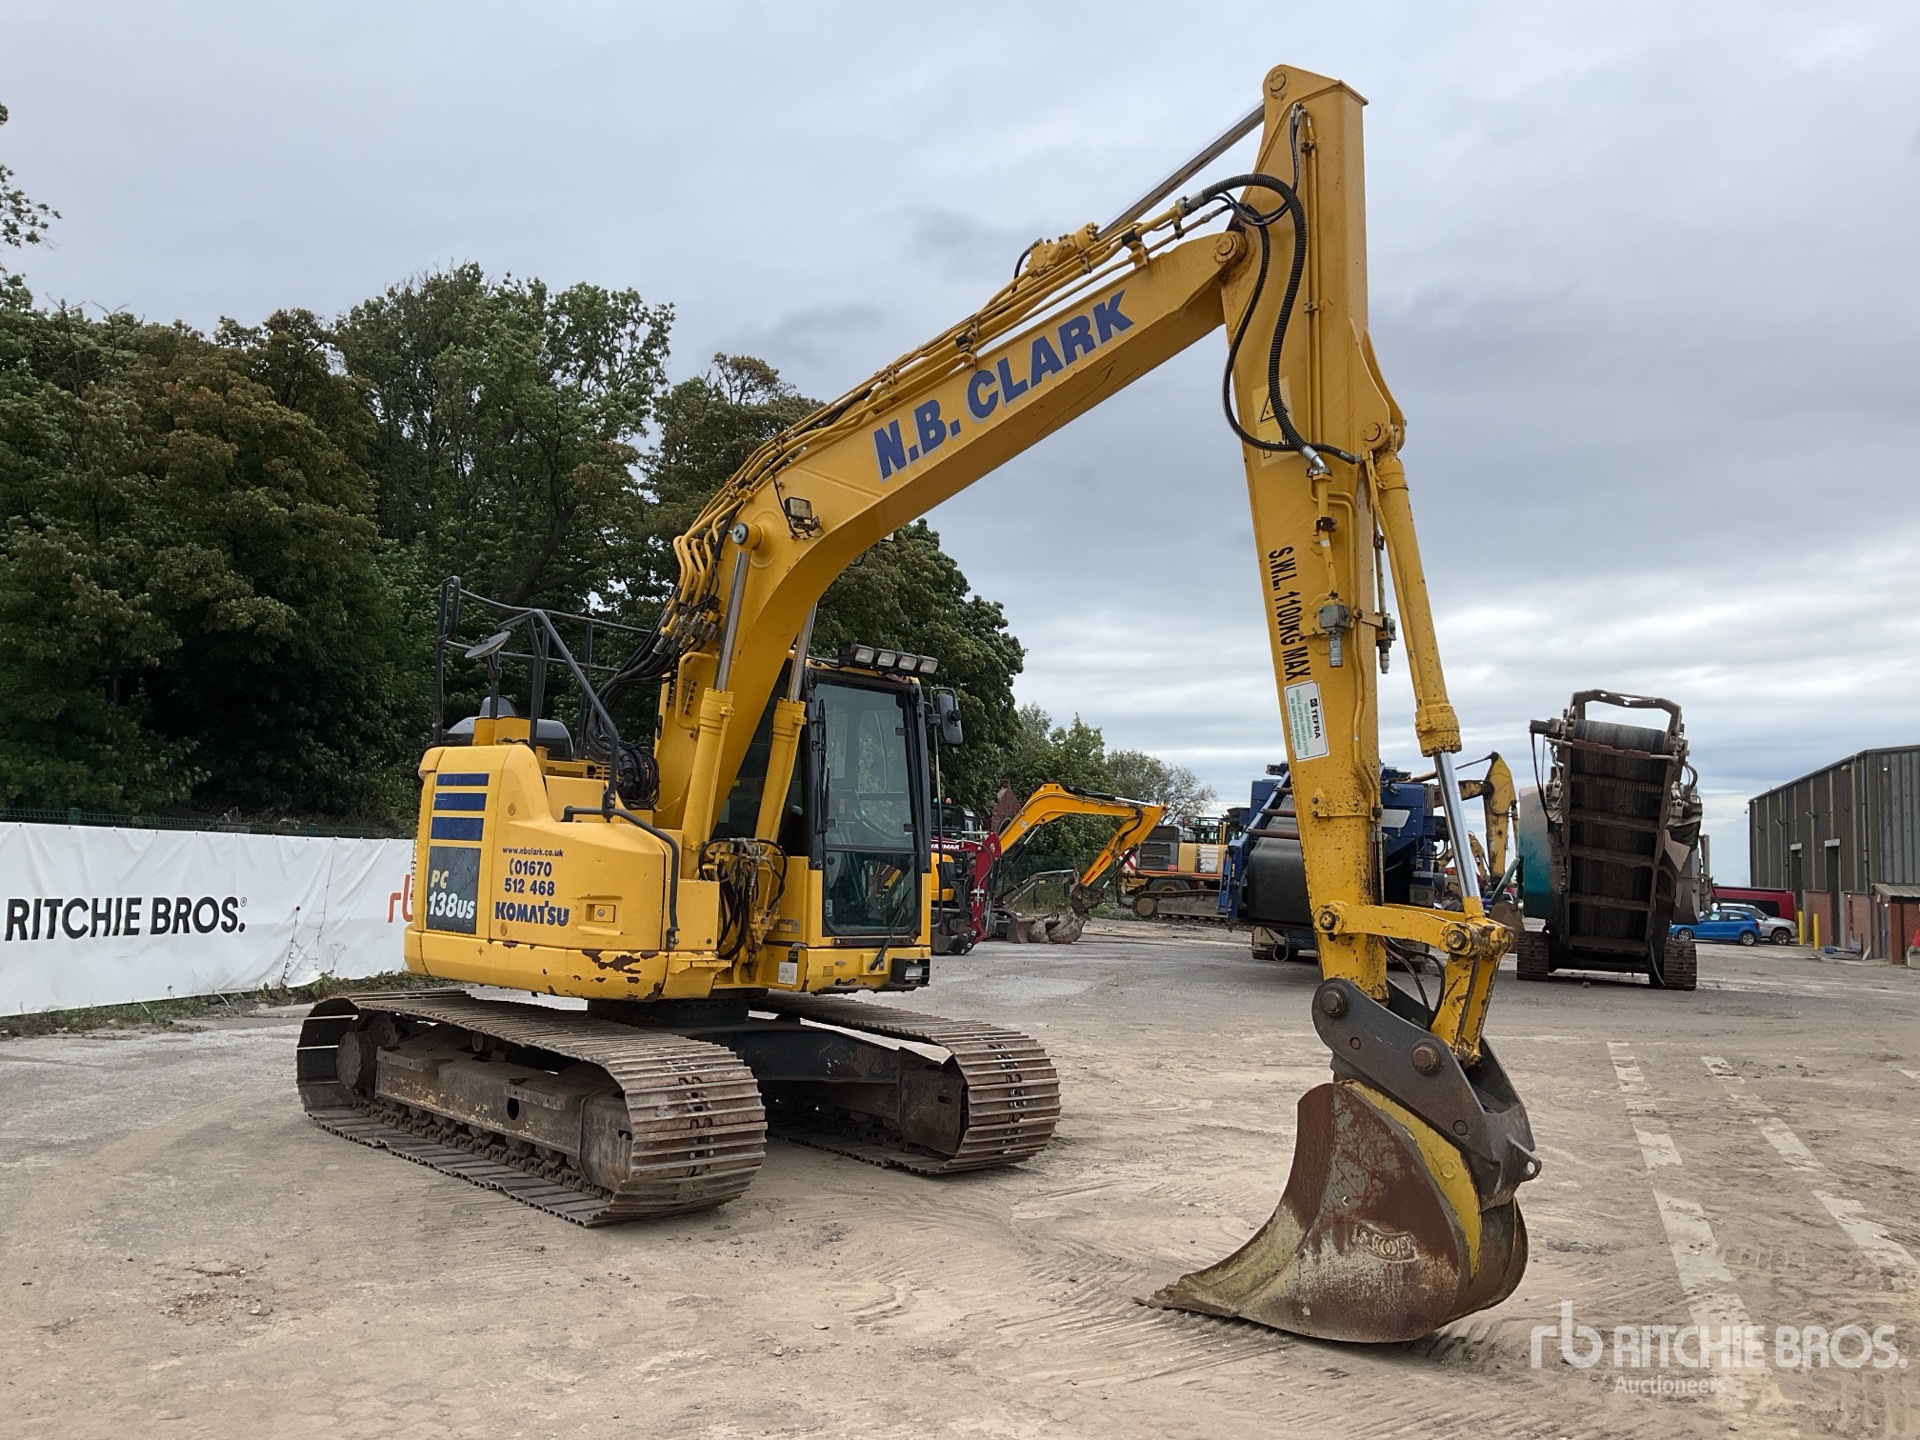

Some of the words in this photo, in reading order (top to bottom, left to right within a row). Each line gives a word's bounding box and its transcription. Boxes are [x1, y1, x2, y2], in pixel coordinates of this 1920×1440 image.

[873, 399, 961, 482] N.B.
[967, 289, 1135, 421] CLARK
[1268, 546, 1297, 591] S.W.L.
[1275, 591, 1306, 646] 1100KG
[1282, 645, 1311, 681] MAX
[1311, 708, 1321, 739] TEFRA
[502, 847, 564, 857] www.nbclark.co.uk
[430, 869, 450, 889] PC
[504, 877, 525, 894] 512
[530, 880, 555, 896] 468
[5, 897, 142, 942] RITCHIE
[494, 900, 570, 927] KOMATSU
